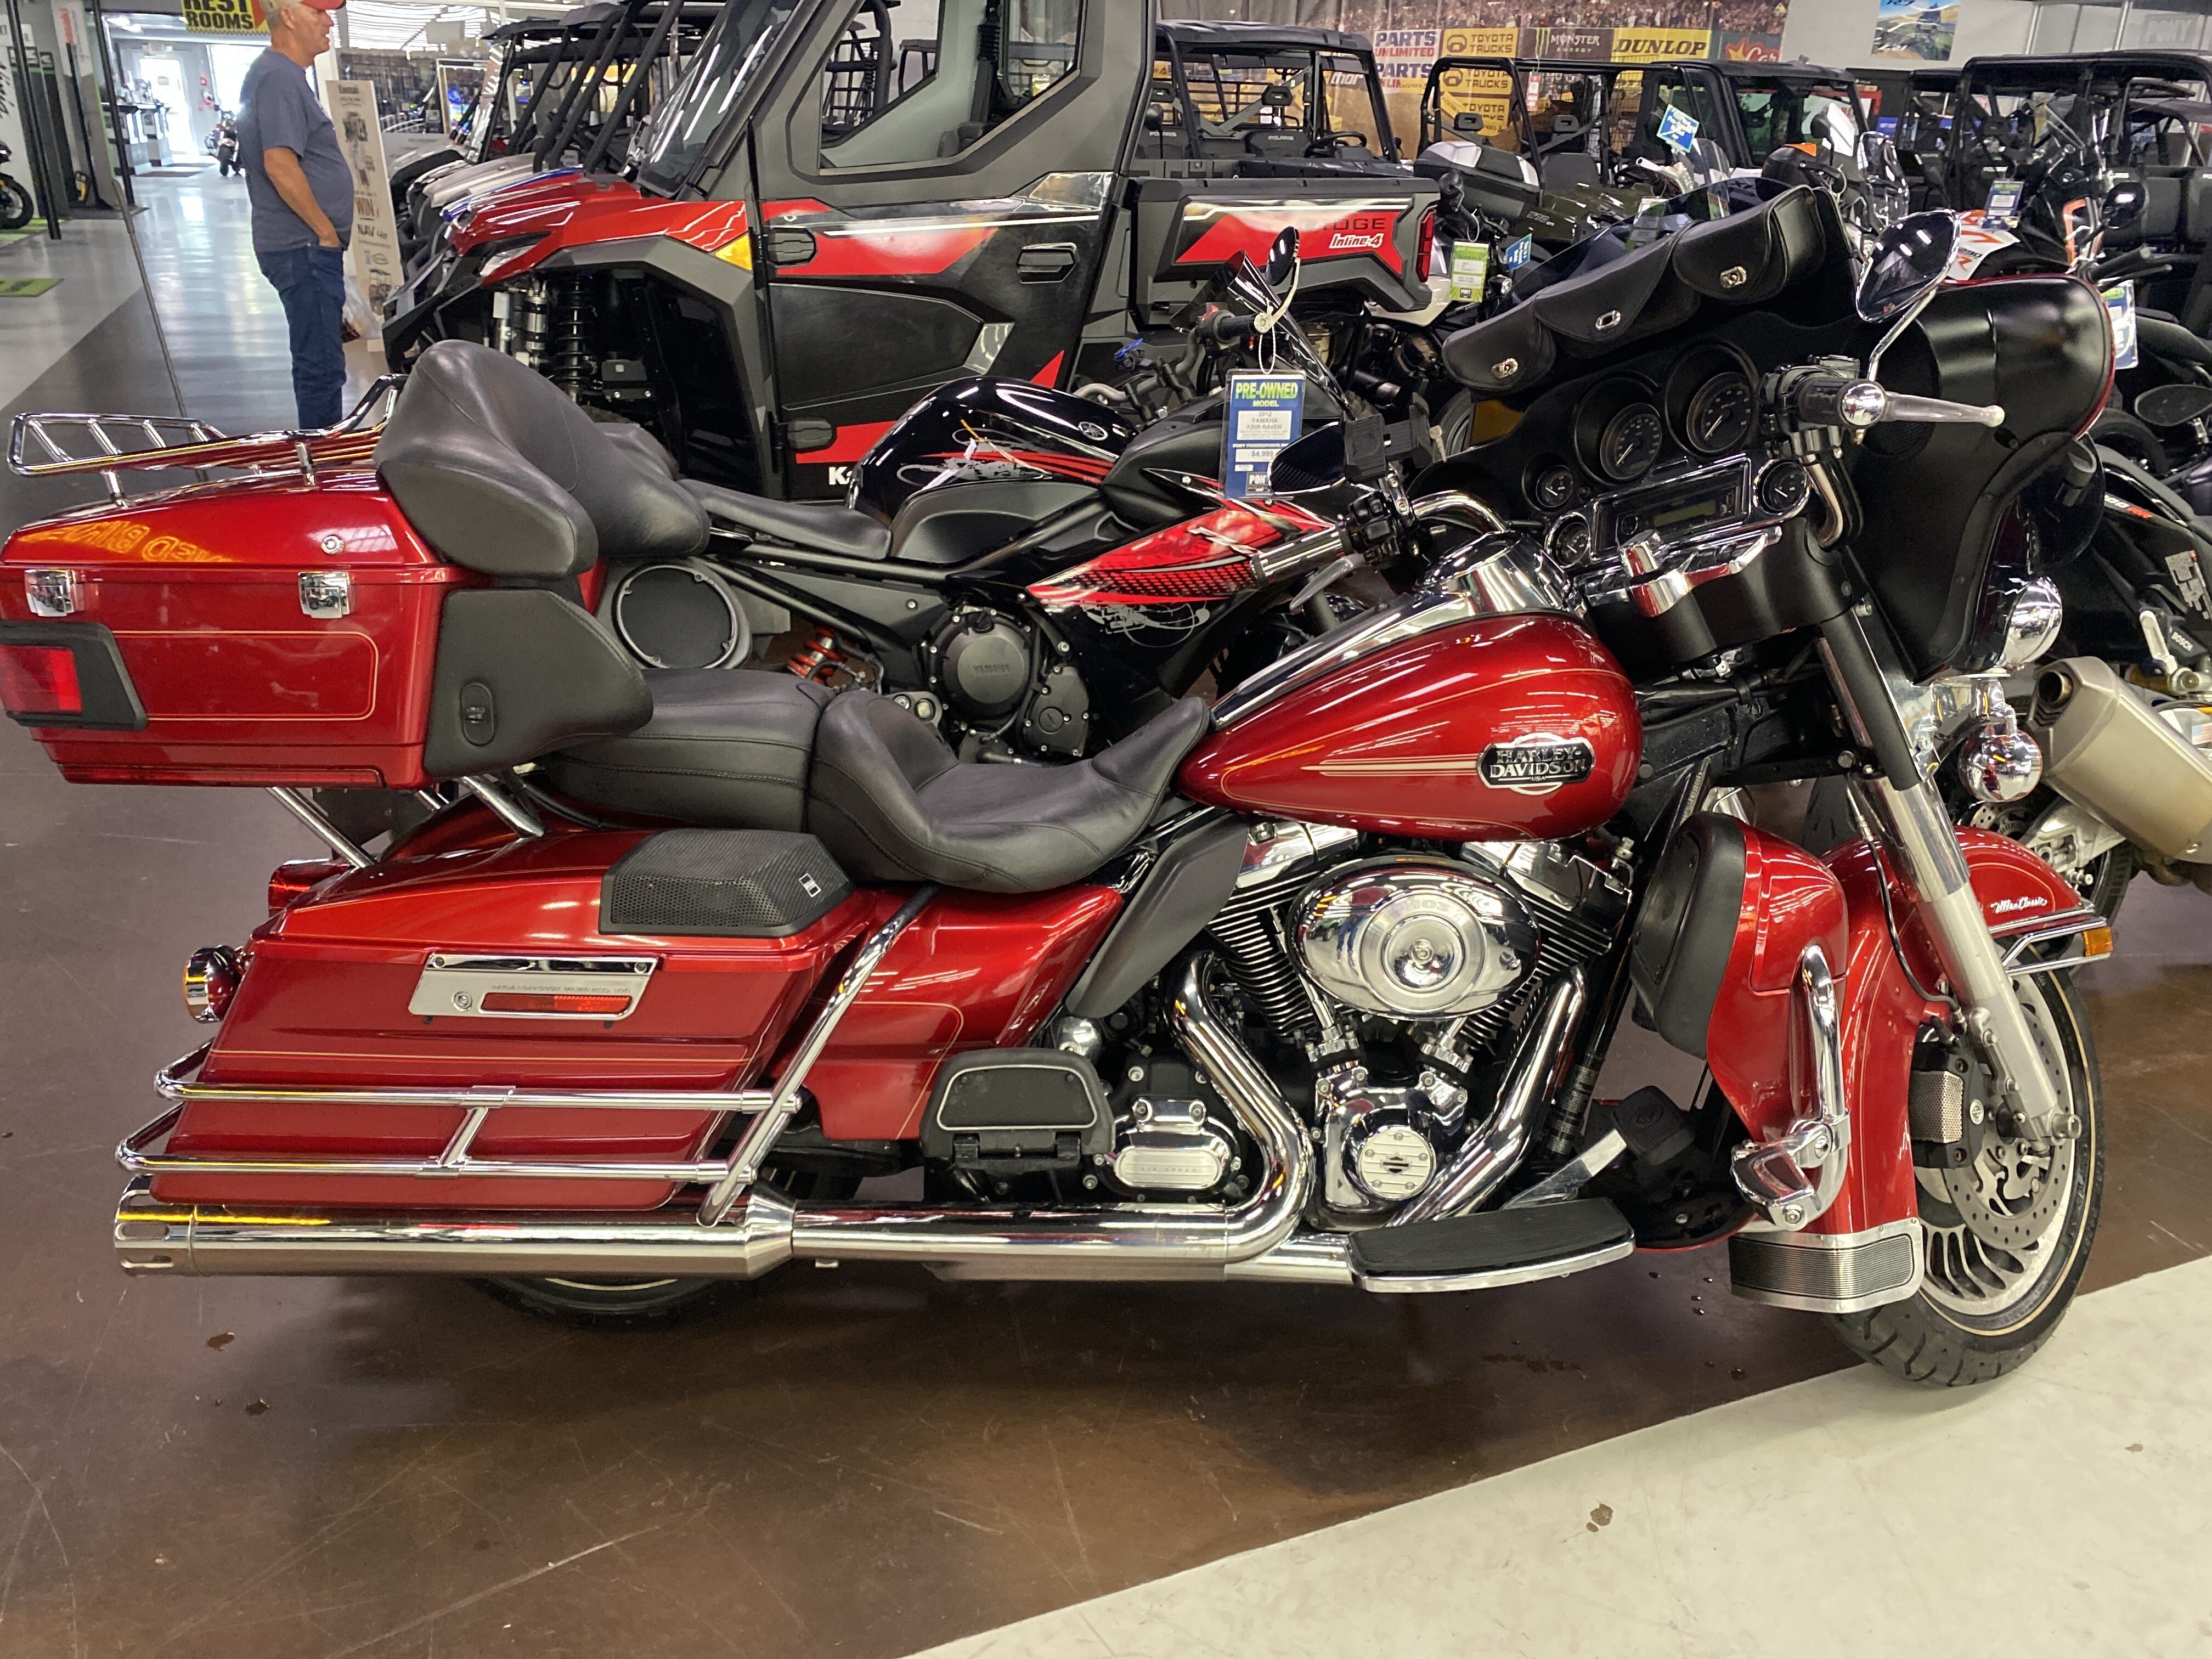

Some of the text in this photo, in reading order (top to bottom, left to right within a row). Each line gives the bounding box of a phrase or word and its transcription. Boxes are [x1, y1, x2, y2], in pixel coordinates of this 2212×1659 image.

[185, 11, 253, 29] ROOMS
[1375, 31, 1436, 47] PARTS
[1471, 34, 1513, 43] TOYOTA
[1551, 33, 1600, 47] MONSTER
[1375, 47, 1434, 57] UNLIMITED
[1470, 44, 1513, 53] TRUCKS
[1613, 39, 1707, 55] DUNLOP
[1376, 63, 1433, 78] PARTS
[1466, 79, 1508, 88] TRUCKS
[1463, 103, 1505, 112] TOYOTA
[357, 224, 375, 236] NAV
[1235, 382, 1299, 399] PRE-OWNED
[1249, 474, 1268, 485] PON
[2171, 631, 2194, 652] BOSCH
[972, 664, 1011, 674] YAMAHA
[1496, 746, 1582, 764] HARLEY-
[1489, 758, 1587, 778] DAVIDSON
